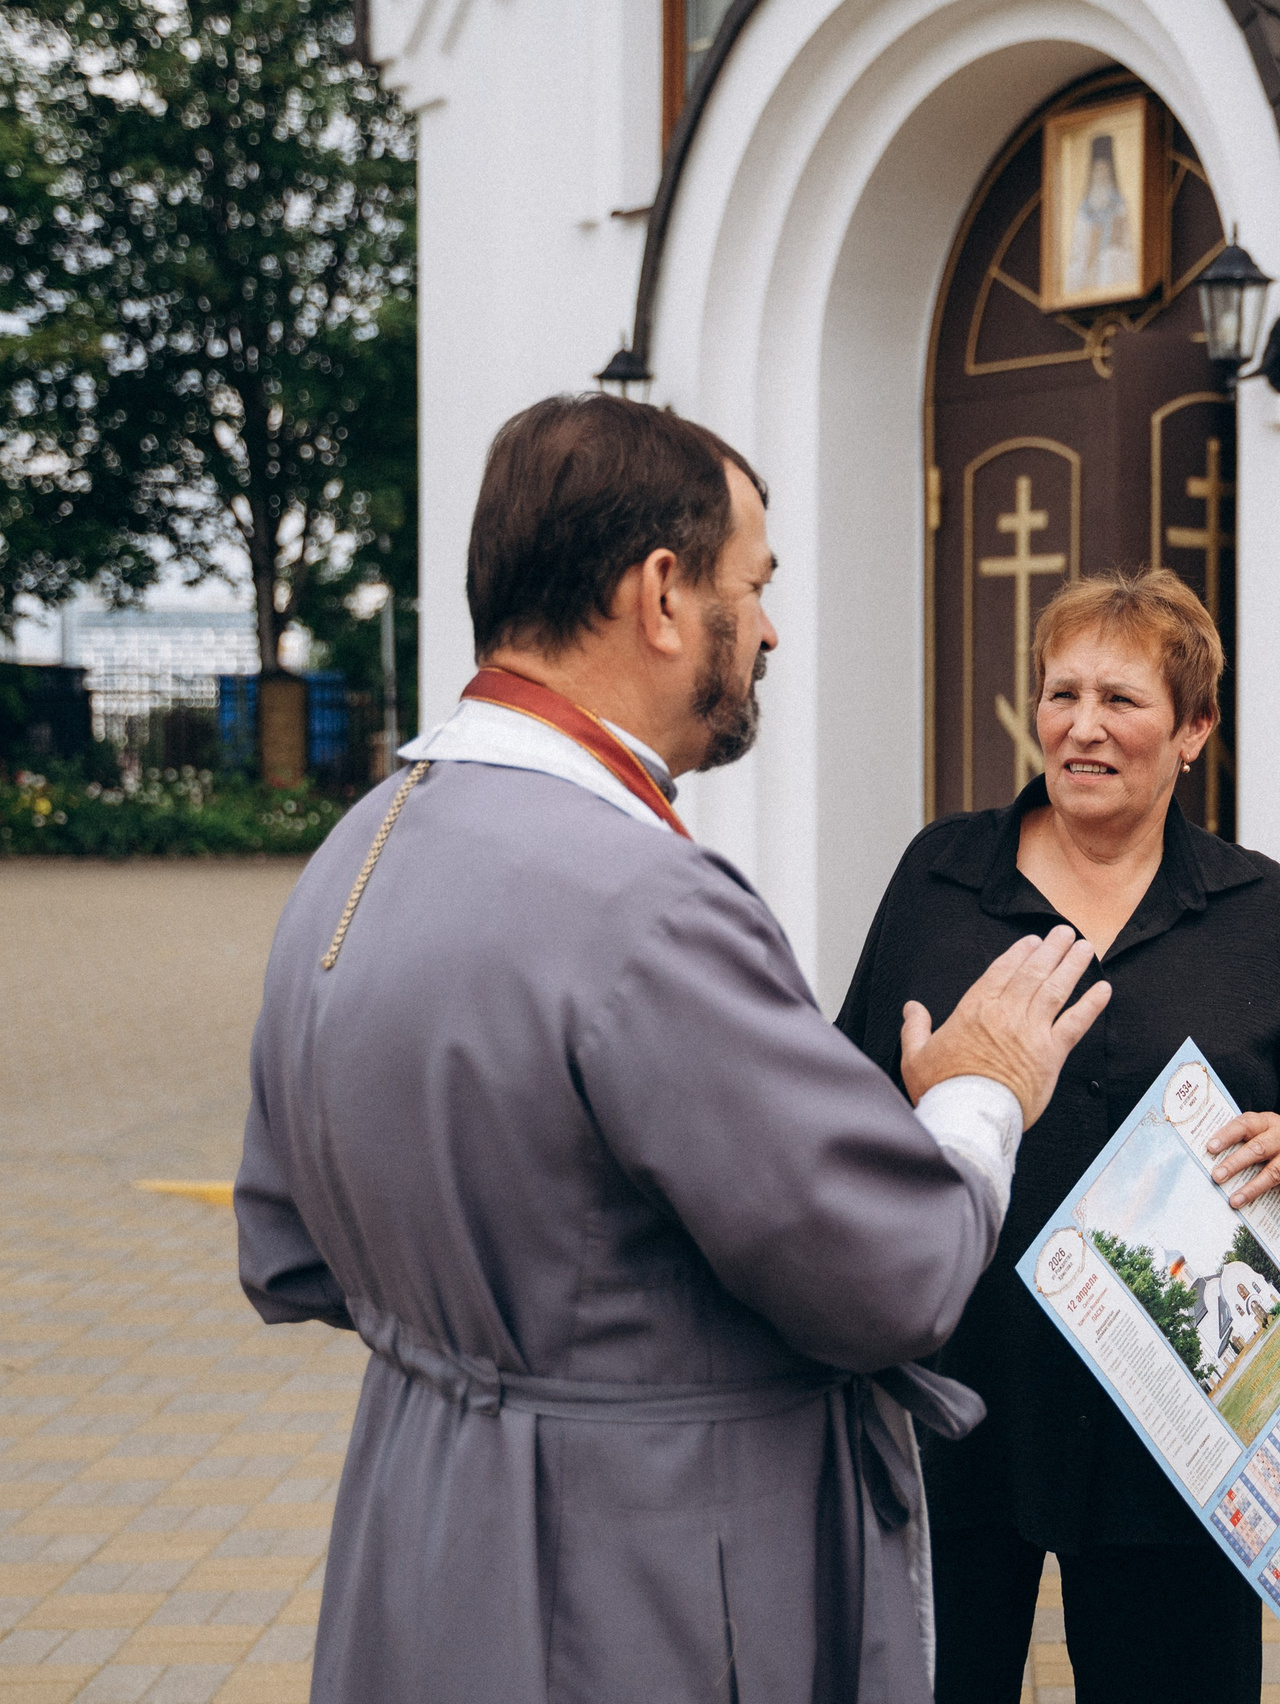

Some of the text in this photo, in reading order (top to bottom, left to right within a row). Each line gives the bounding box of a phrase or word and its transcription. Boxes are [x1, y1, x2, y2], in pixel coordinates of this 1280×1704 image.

[1176, 1079, 1191, 1100] 7534
[1048, 1247, 1065, 1270] 2026
[1055, 1252, 1071, 1274] Рождества
[1067, 1273, 1098, 1312] 12 апреля
[1092, 1304, 1104, 1321] ПАСХА
